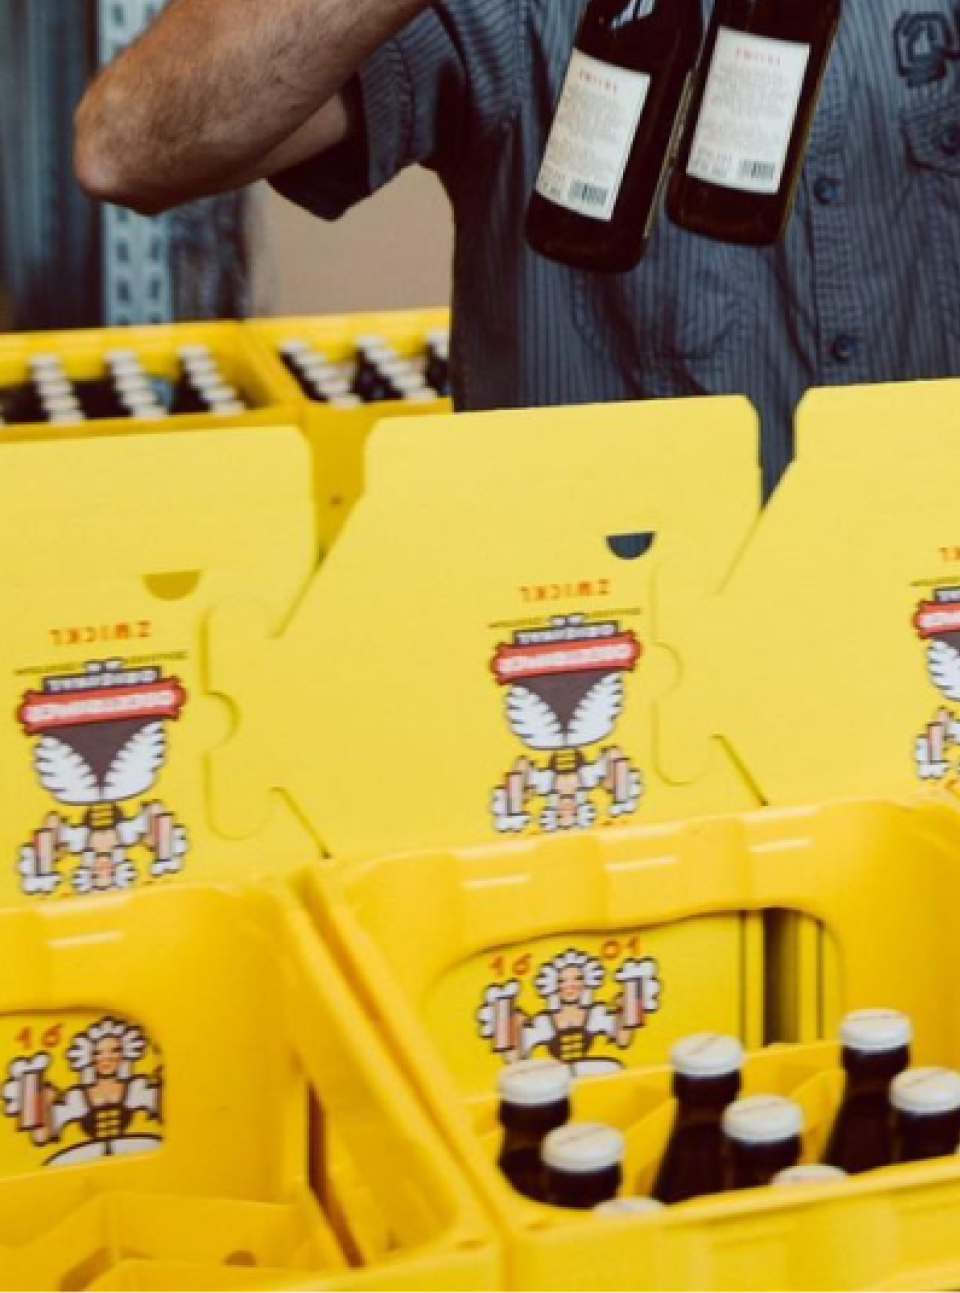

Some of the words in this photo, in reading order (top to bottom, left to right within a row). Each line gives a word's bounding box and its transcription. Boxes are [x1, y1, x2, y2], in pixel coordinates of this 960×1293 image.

[519, 578, 610, 602] ZWICKL
[49, 619, 151, 645] ZWICKL
[489, 953, 532, 976] 16
[600, 935, 641, 960] 01
[15, 1023, 63, 1050] 16
